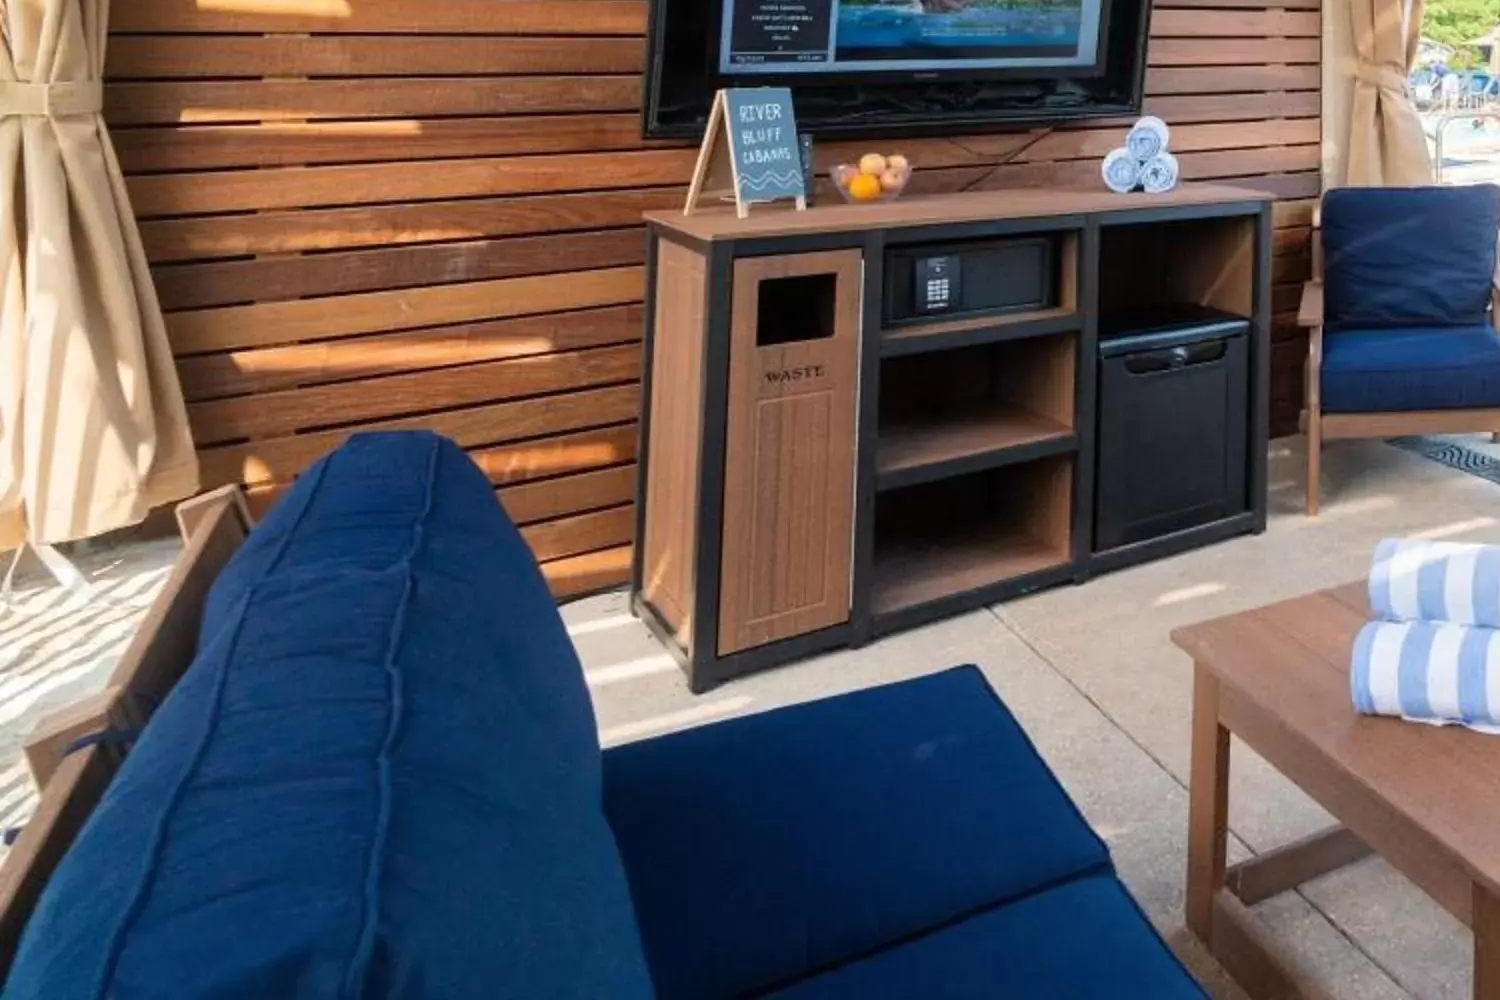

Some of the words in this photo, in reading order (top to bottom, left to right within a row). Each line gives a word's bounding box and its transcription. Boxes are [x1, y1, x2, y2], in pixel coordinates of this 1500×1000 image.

[739, 103, 782, 122] RIVER
[741, 127, 781, 145] BLUFF
[743, 147, 792, 165] CABANAS
[765, 365, 826, 383] WASTE
